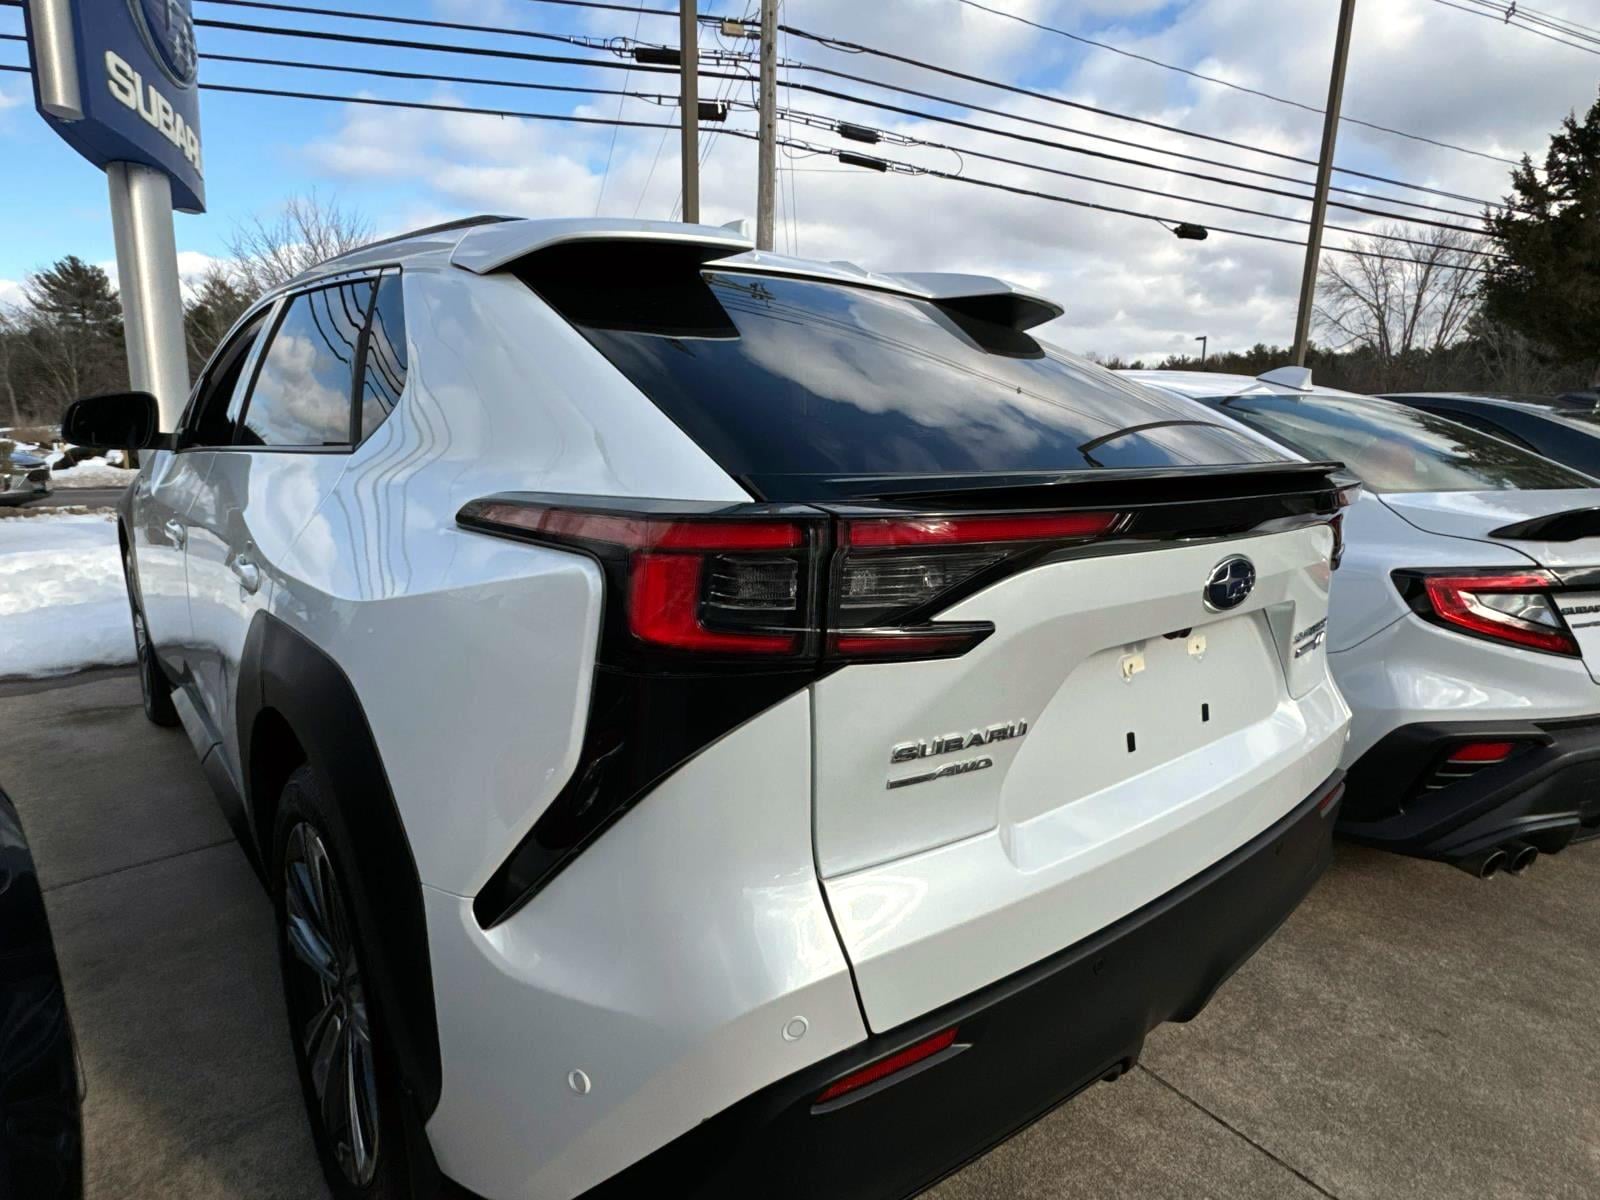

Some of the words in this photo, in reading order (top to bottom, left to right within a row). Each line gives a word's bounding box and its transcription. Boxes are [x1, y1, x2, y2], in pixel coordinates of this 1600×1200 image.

[105, 50, 204, 180] SUBAR
[891, 717, 1028, 764] SUBARU
[935, 755, 993, 780] AWD
